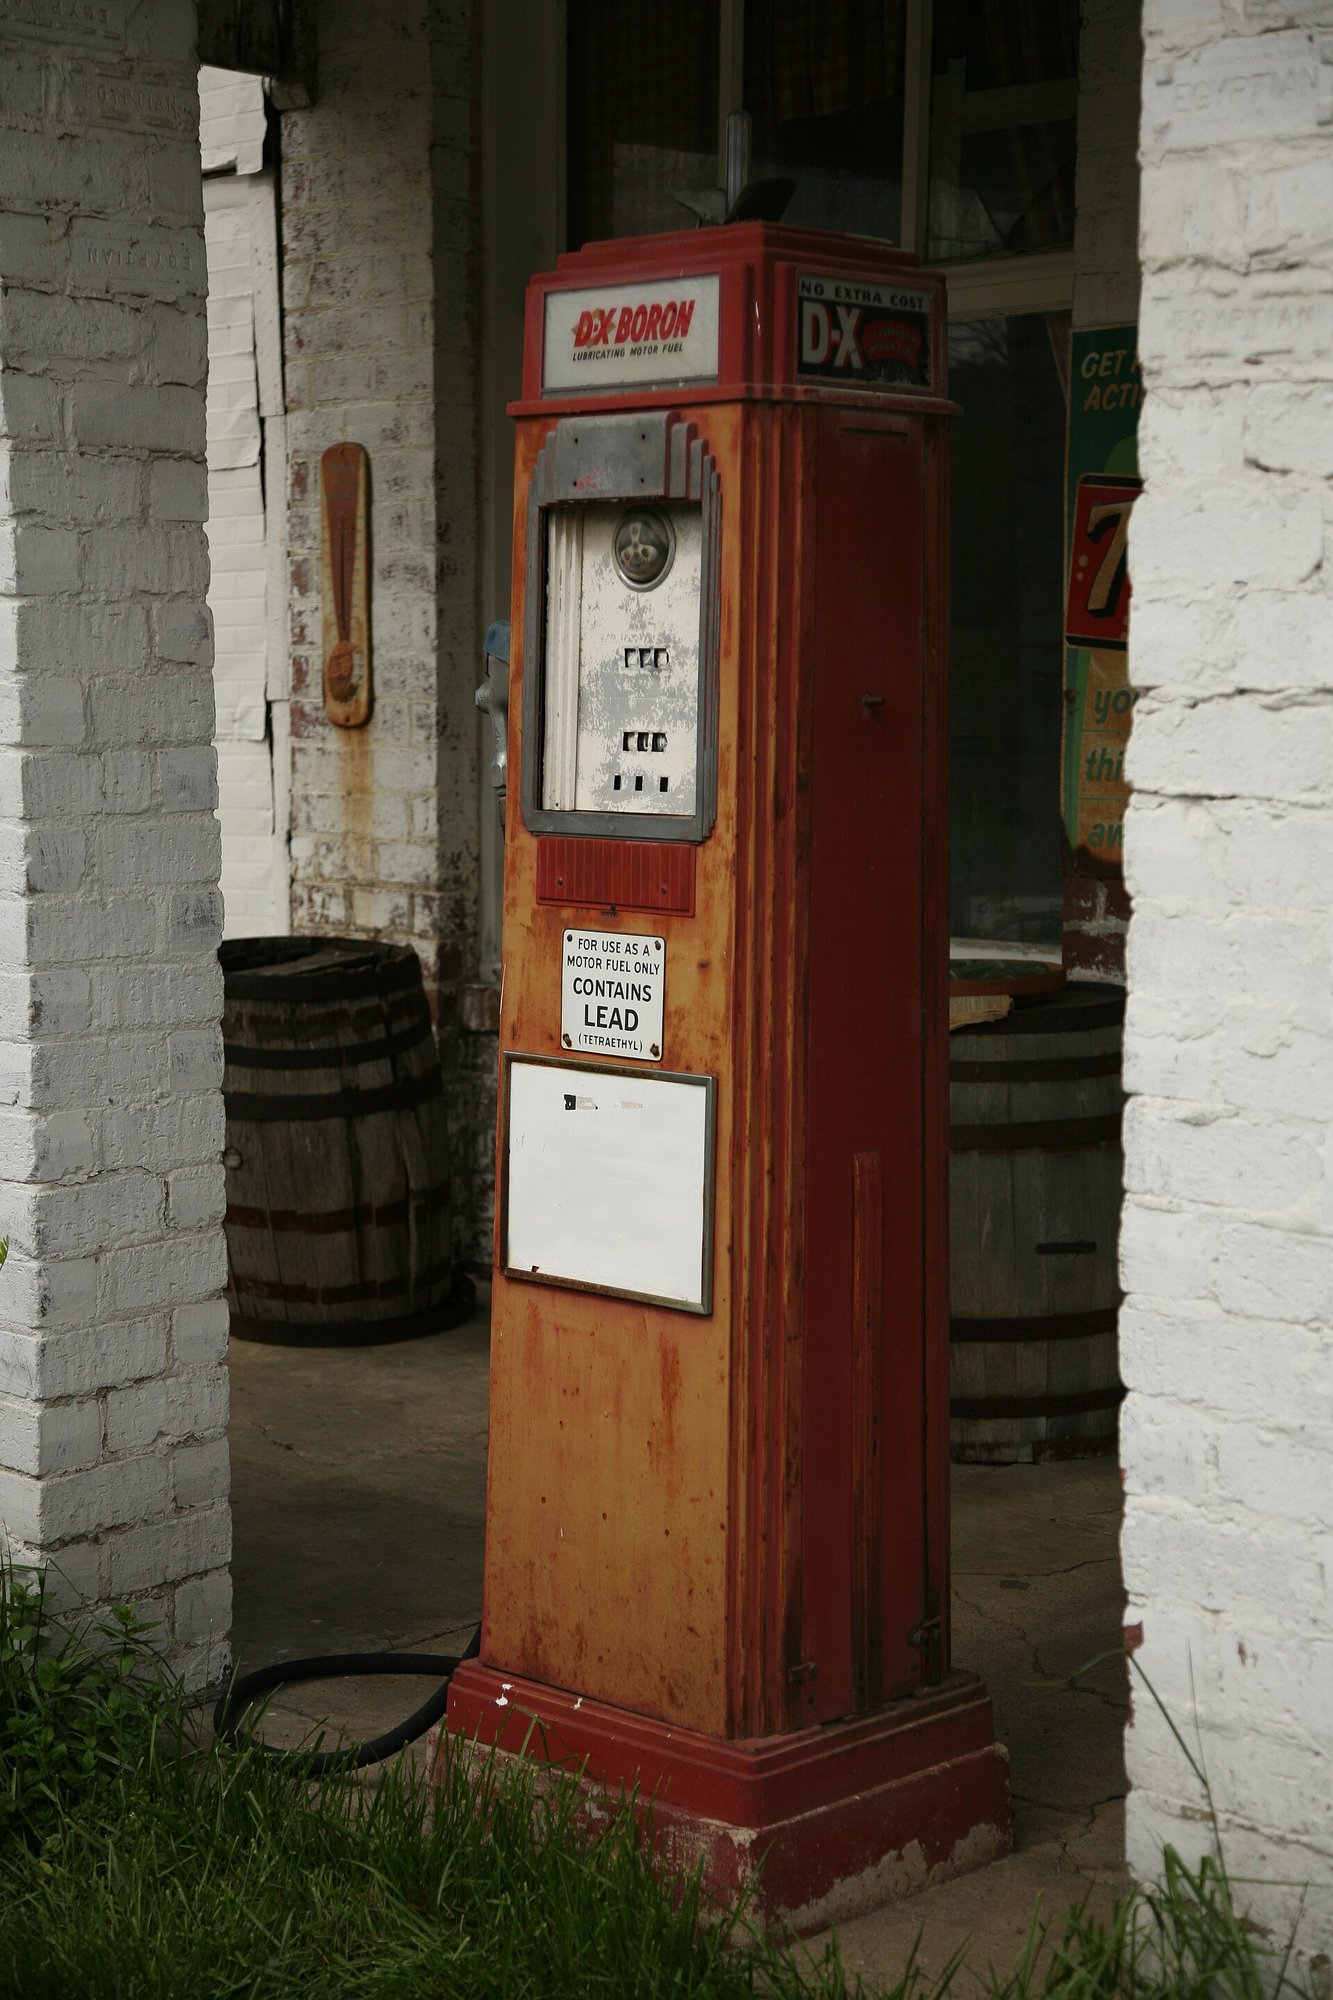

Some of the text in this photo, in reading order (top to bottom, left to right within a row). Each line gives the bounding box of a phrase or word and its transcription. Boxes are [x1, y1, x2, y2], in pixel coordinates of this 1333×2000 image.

[1174, 66, 1319, 112] EGYPTIAN
[88, 247, 192, 271] EGYPTIAN
[801, 281, 925, 310] NO EXTRA COST
[615, 299, 695, 343] BORON
[1173, 305, 1314, 331] EGYPTIAN
[802, 300, 864, 369] D-X
[572, 343, 683, 361] LUBRICATING MOTOR FUEL
[1080, 349, 1128, 379] GET
[1082, 382, 1145, 412] ACTI
[1093, 688, 1139, 724] yo
[578, 938, 650, 956] FOR USE AS A
[567, 955, 660, 975] MOTOR FUEL ONLY
[573, 977, 652, 1002] CONTAINS
[584, 1004, 639, 1031] LEAD
